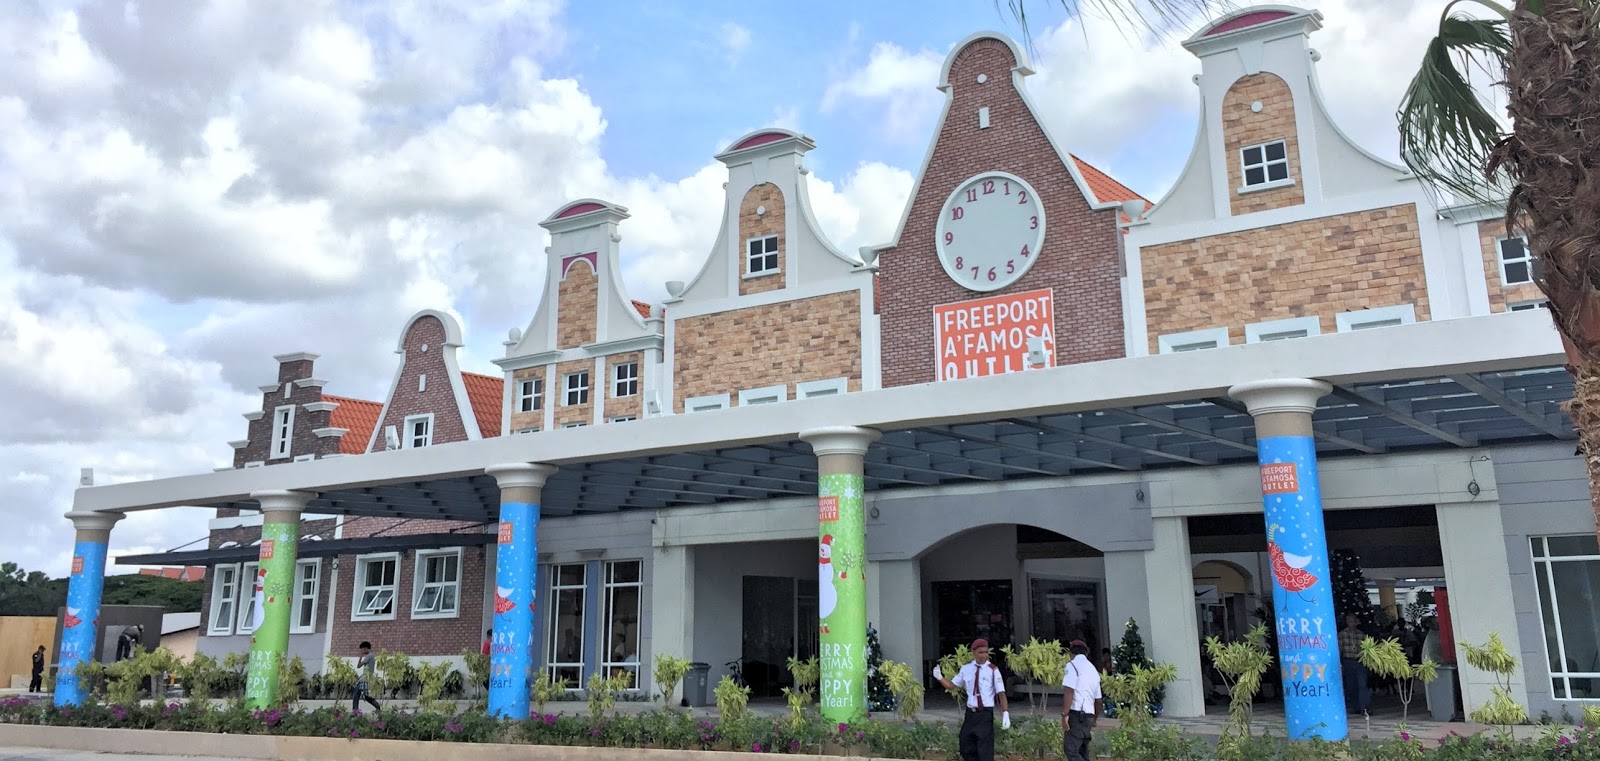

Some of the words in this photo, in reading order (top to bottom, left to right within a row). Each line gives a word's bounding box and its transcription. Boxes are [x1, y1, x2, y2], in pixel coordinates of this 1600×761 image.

[982, 181, 995, 195] 12
[1004, 182, 1010, 195] 1
[966, 188, 977, 202] 11
[1018, 191, 1028, 204] 2
[952, 207, 964, 220] 10
[1030, 216, 1038, 229] 3
[945, 232, 953, 245] 9
[1021, 244, 1029, 257] 4
[956, 257, 963, 270] 8
[1006, 260, 1015, 274] 5
[971, 266, 979, 280] 7
[988, 267, 996, 281] 6
[944, 296, 1050, 332] FREEPORT
[494, 631, 515, 644] RRY
[1278, 634, 1327, 651] RISTMAS
[251, 650, 271, 660] RRY
[820, 642, 852, 657] ERRY
[1281, 662, 1326, 682] APPY
[1292, 681, 1330, 697] Year!
[825, 694, 853, 707] Year!
